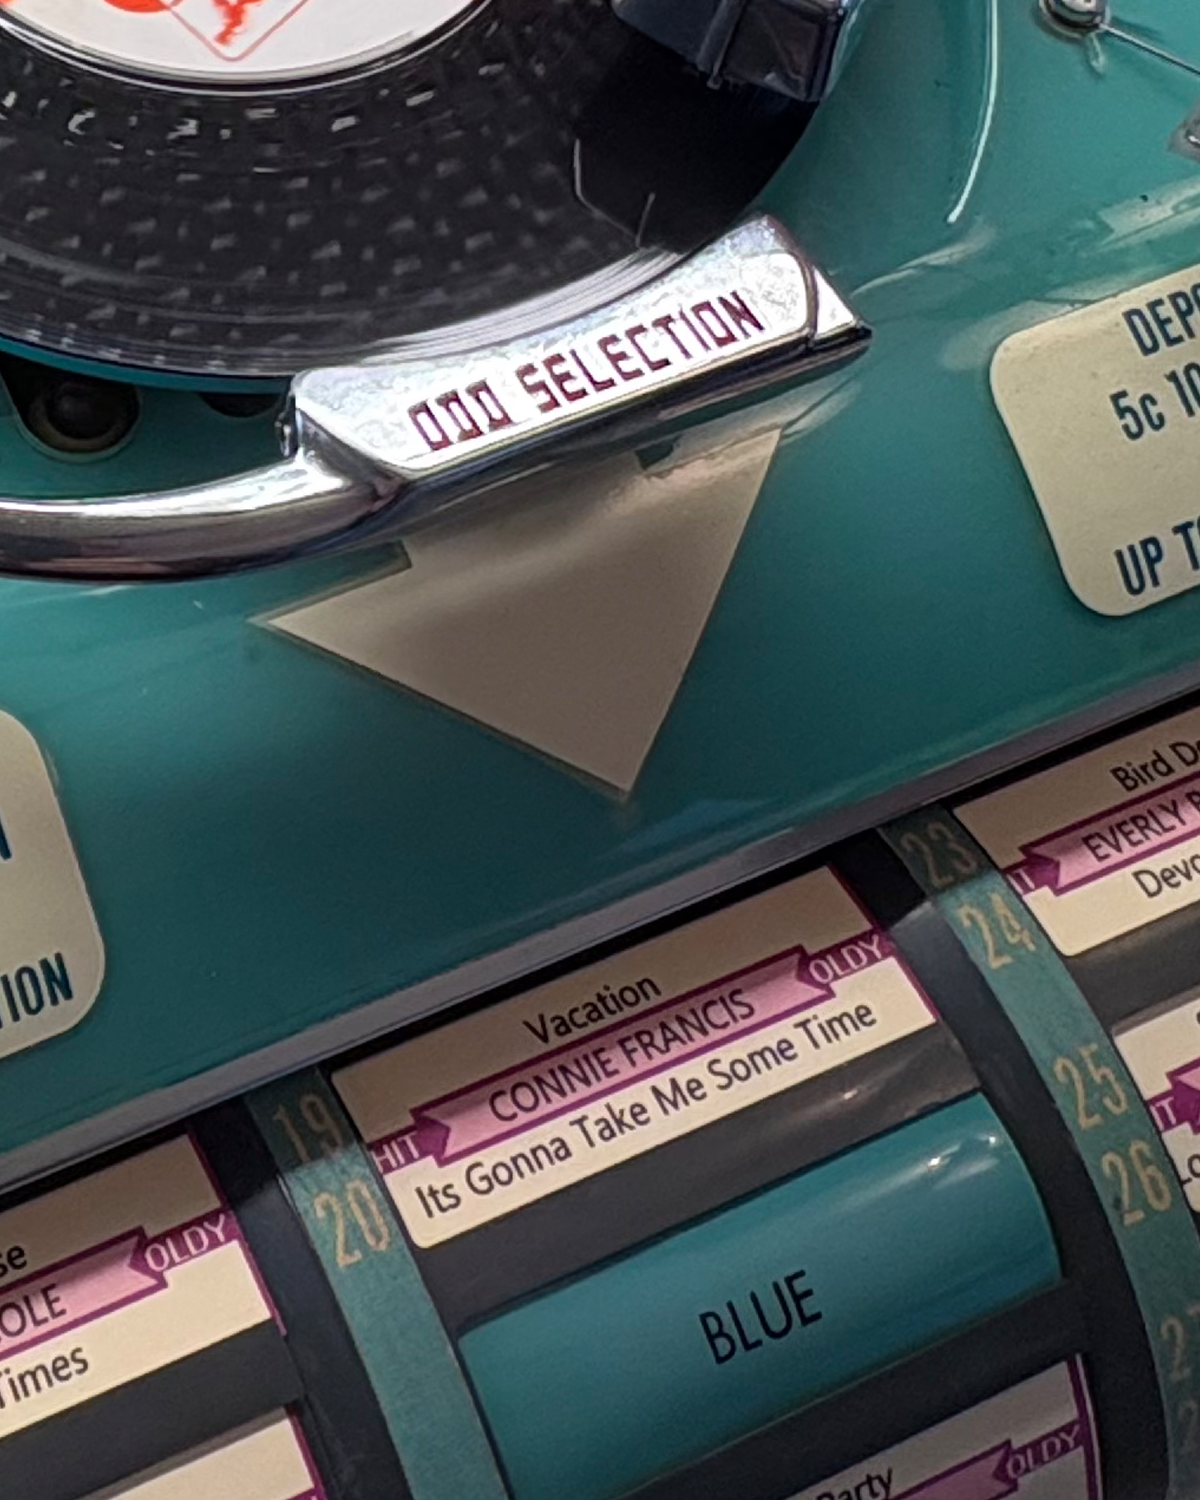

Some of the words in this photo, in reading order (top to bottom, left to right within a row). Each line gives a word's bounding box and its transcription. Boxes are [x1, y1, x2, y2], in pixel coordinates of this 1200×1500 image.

[514, 289, 765, 414] SELECTION
[1109, 389, 1166, 442] 5c
[1114, 535, 1164, 596] UP
[1171, 514, 1200, 572] T
[1110, 749, 1175, 793] Bird
[1169, 740, 1200, 767] D
[900, 821, 978, 889] 23
[1082, 799, 1188, 863] EVERLY
[808, 934, 882, 987] OLDY
[956, 892, 1037, 970] 24
[523, 974, 662, 1045] Vacation
[488, 1045, 620, 1123] CONNIE
[617, 988, 756, 1069] FRANCIS
[1053, 1043, 1129, 1132] 25
[273, 1093, 344, 1165] 19
[415, 1181, 461, 1219] Its
[464, 1136, 573, 1197] Gonna
[569, 1100, 651, 1149] Take
[651, 1073, 707, 1112] Me
[707, 1034, 799, 1091] Some
[793, 1000, 877, 1051] Time
[370, 1130, 420, 1175] HIT
[1101, 1138, 1173, 1226] 26
[144, 1213, 228, 1275] OLDY
[314, 1179, 391, 1268] 20
[698, 1270, 823, 1365] BLUE
[1005, 1423, 1084, 1479] OLDY
